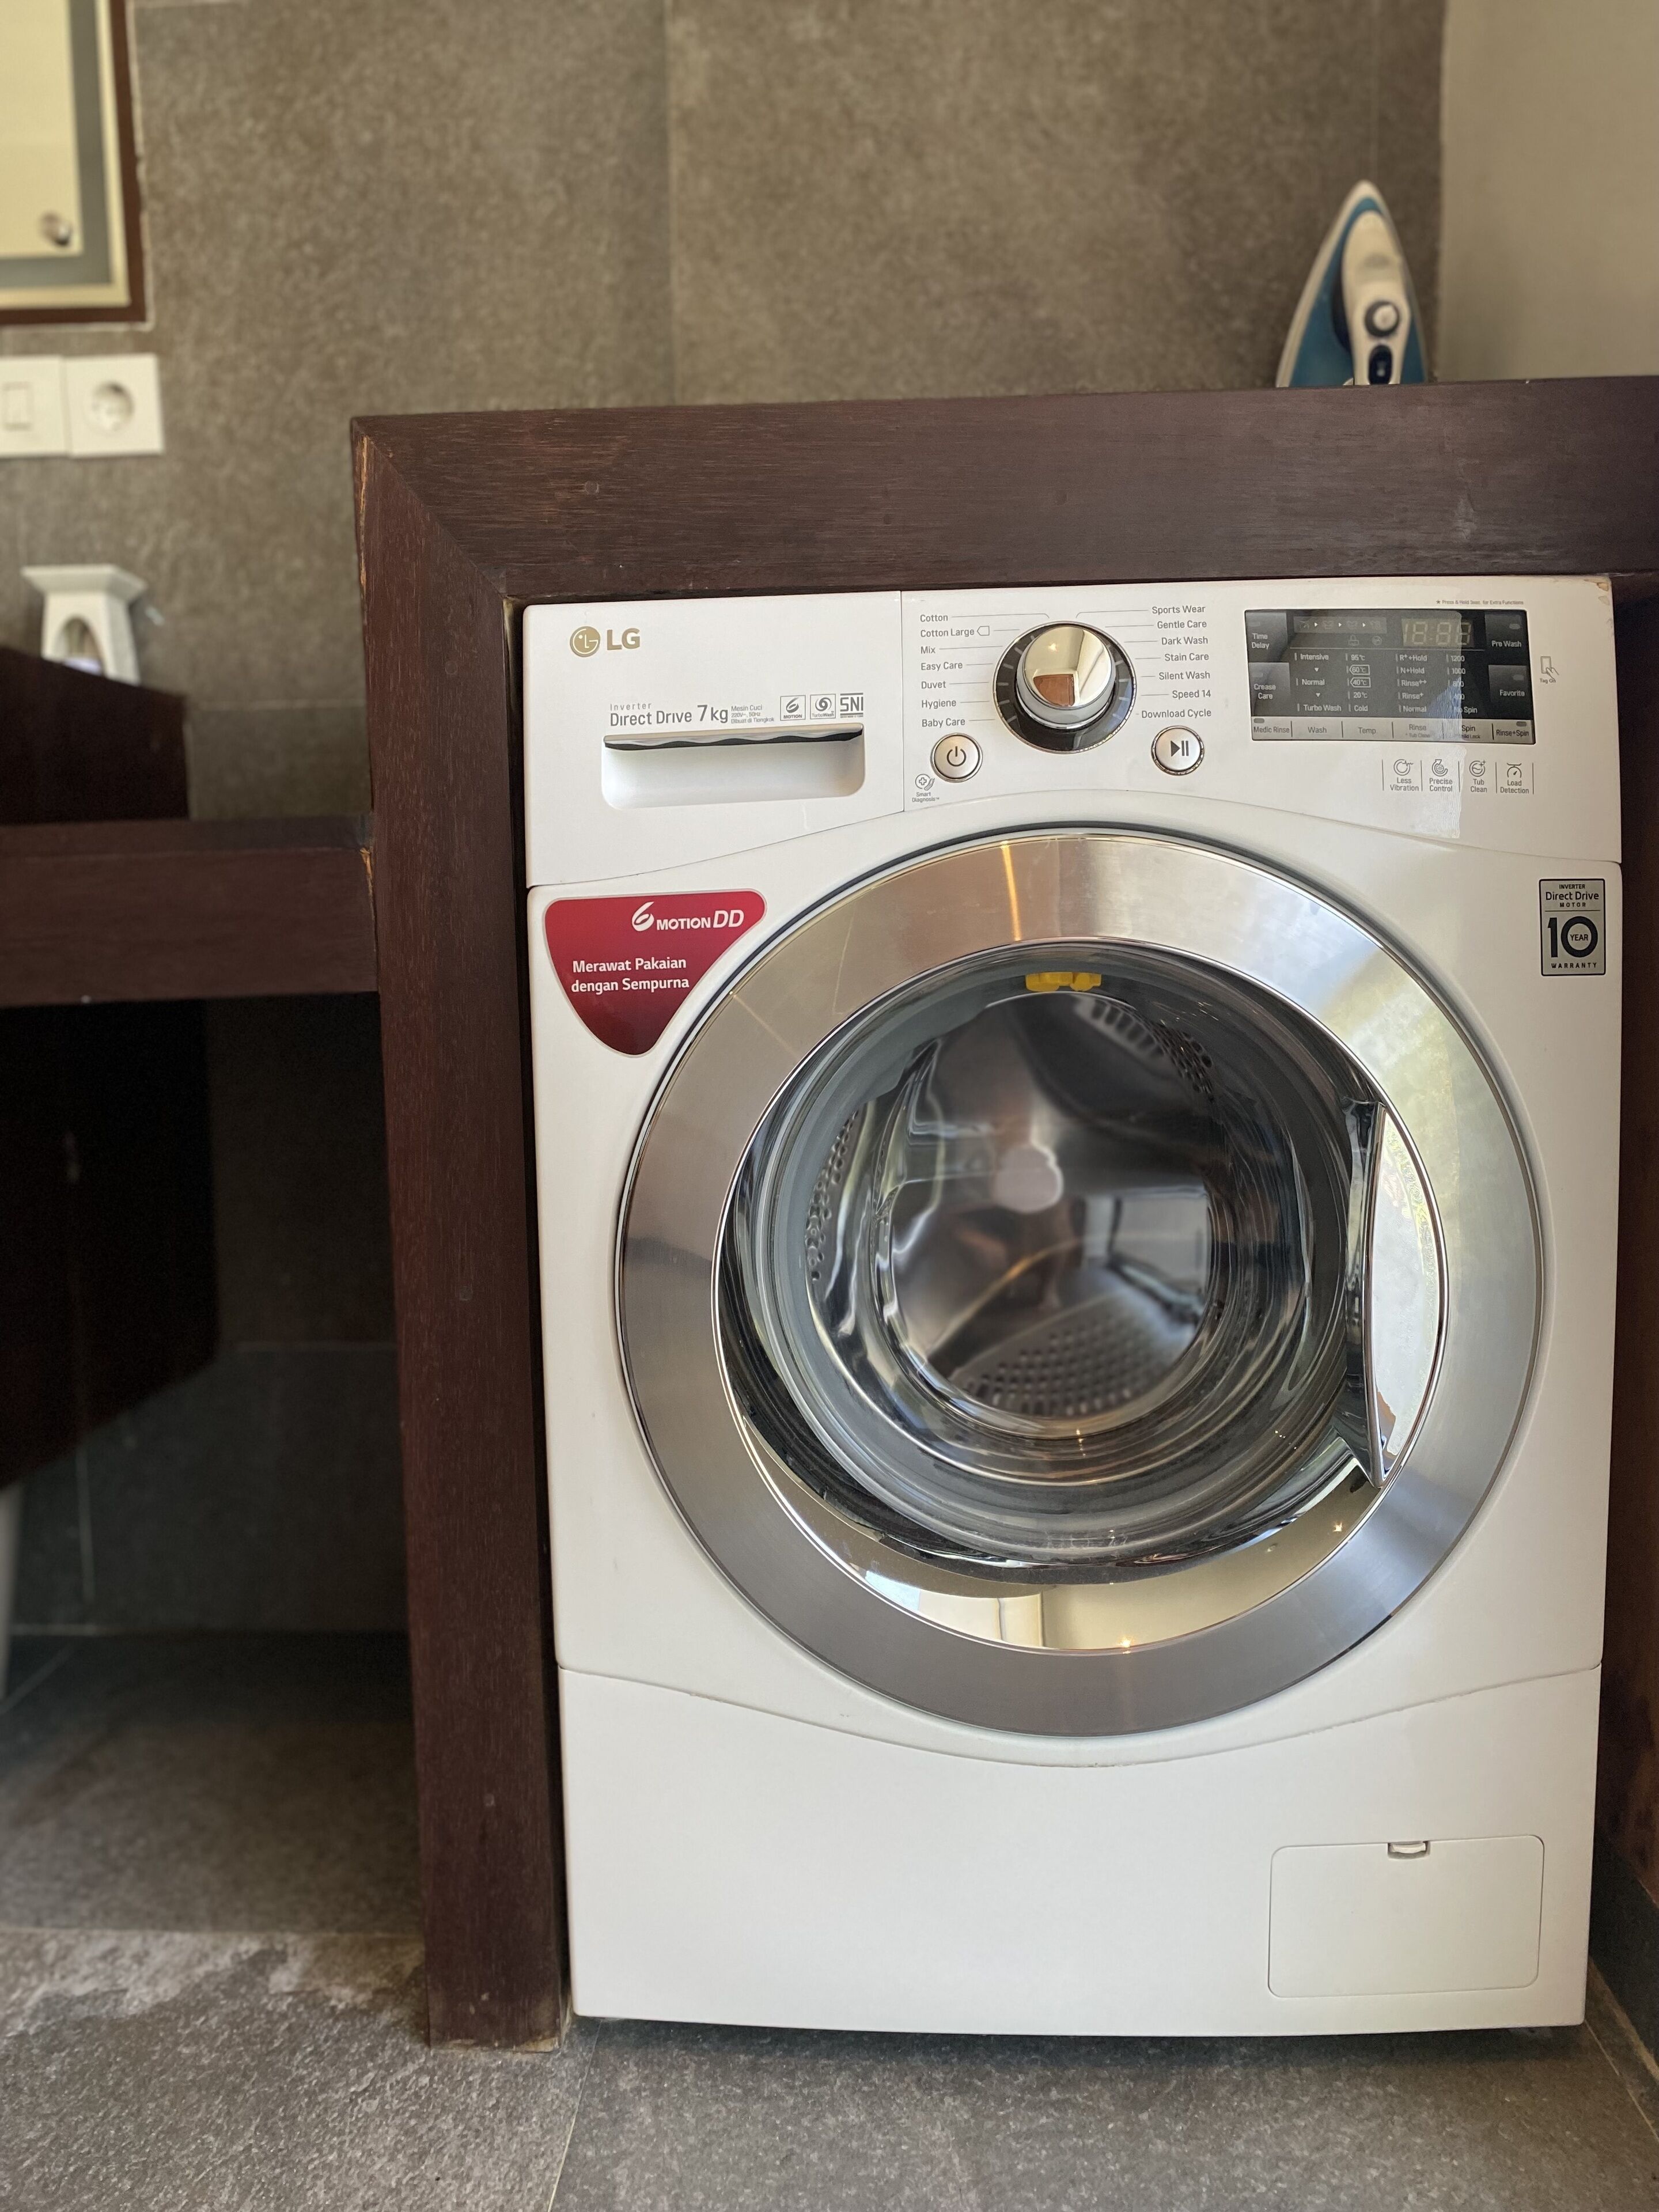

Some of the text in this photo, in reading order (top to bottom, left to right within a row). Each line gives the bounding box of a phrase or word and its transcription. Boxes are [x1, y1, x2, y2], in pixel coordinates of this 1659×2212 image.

[1152, 605, 1206, 615] Sports Wear
[920, 614, 948, 622] Cotton
[1157, 620, 1207, 628] Gentle Care
[921, 628, 975, 637] Cotton Large
[607, 627, 641, 650] LG
[1161, 636, 1208, 645] Dark Wash
[921, 646, 936, 654] Mix
[1251, 642, 1270, 650] Delay
[1164, 653, 1209, 661] Stain Care
[921, 662, 941, 671] Easy
[1158, 671, 1210, 680] Silent Wash
[921, 681, 946, 689] Duvet
[1172, 689, 1211, 700] Speed 14
[610, 702, 652, 711] Inverter
[840, 696, 863, 712] SNI
[921, 699, 957, 709] Hygiene
[1141, 709, 1212, 719] Download Cycle
[1464, 706, 1478, 714] Spin
[610, 704, 729, 726] Direct Drive 7 kg
[922, 718, 965, 728] Baby Care
[1461, 725, 1476, 733] Spin
[1496, 729, 1529, 738] Rinse+Spin
[1546, 891, 1599, 900] Direct Drive
[656, 917, 711, 930] MOTION
[713, 909, 745, 928] DD
[1547, 915, 1599, 958] 10
[573, 957, 687, 973] Merawat Pakaian
[571, 978, 690, 995] dengan Sempurna
